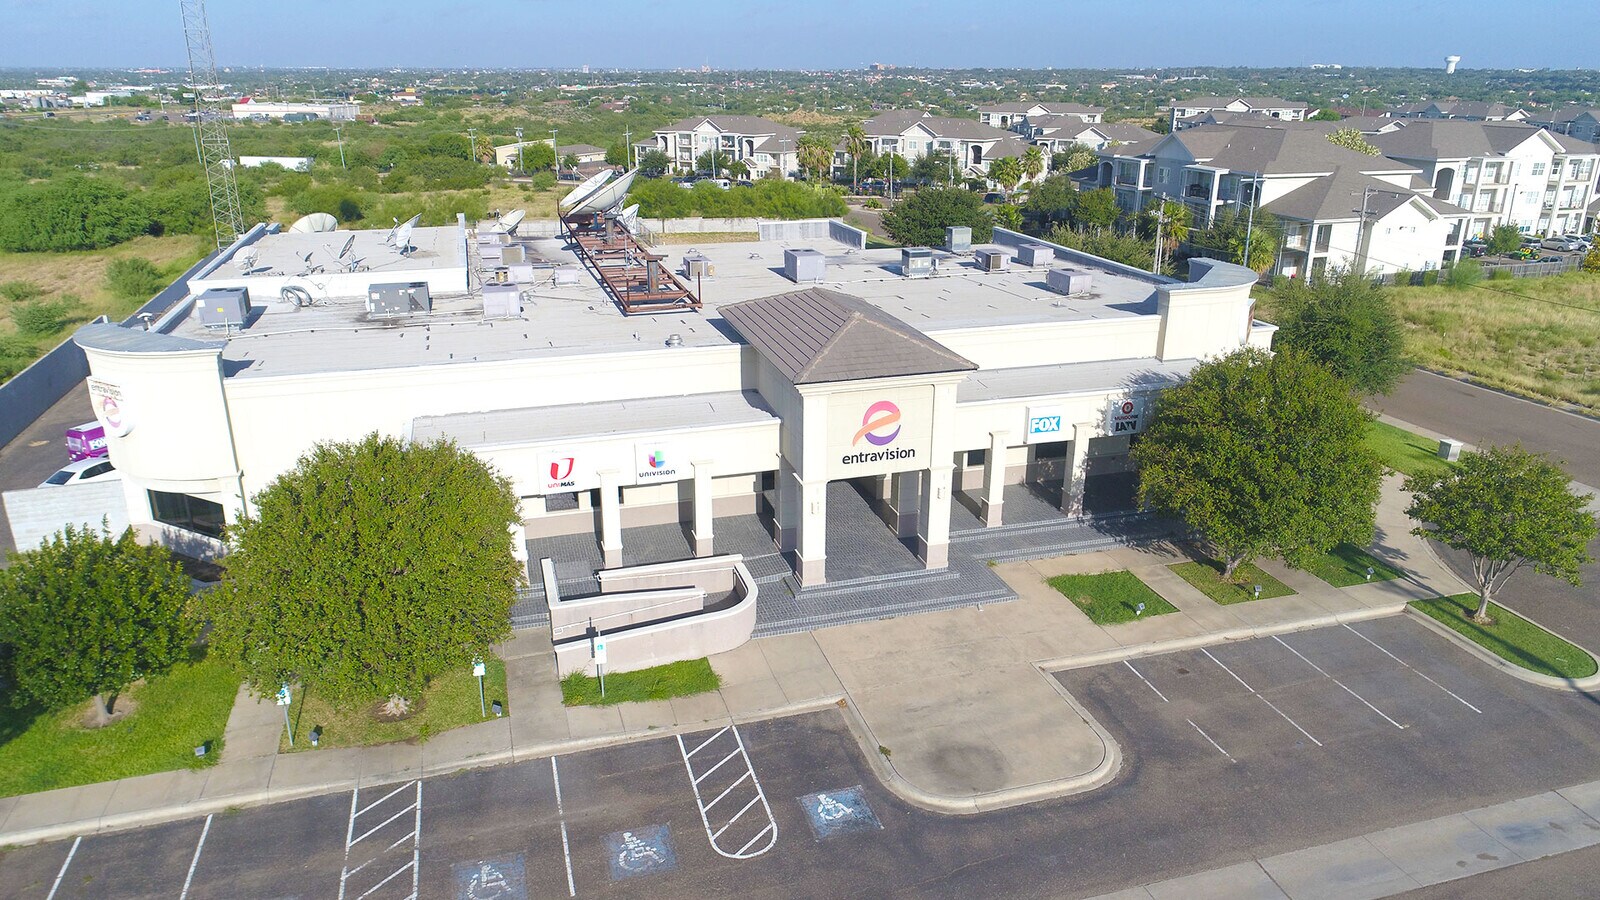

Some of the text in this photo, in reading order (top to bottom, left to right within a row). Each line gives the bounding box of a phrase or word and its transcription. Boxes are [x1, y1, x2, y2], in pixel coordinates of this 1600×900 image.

[1031, 416, 1061, 433] FOX
[842, 447, 916, 464] entravision
[638, 469, 676, 478] UNIVISION
